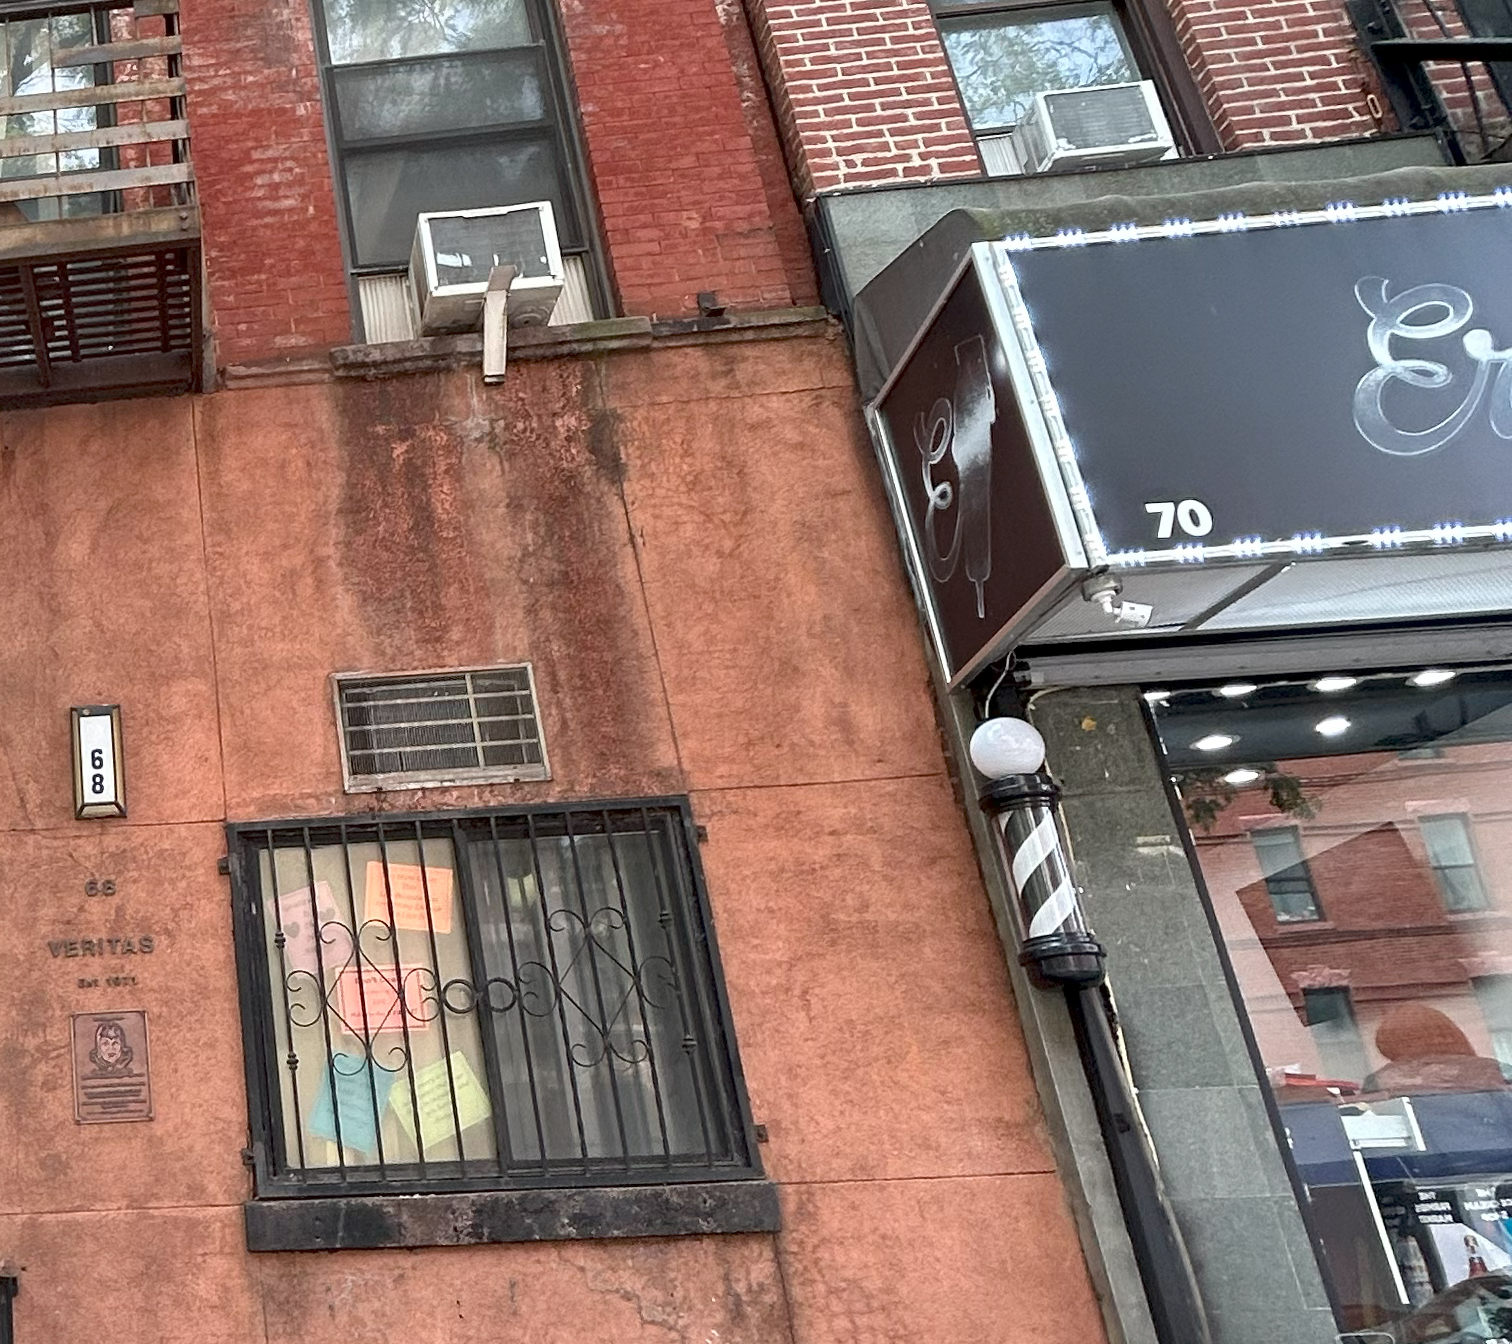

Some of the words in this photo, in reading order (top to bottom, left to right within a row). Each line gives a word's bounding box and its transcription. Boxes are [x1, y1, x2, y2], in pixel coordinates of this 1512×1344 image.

[1144, 499, 1214, 539] 70
[91, 748, 105, 794] 68
[48, 936, 154, 958] VERITAS
